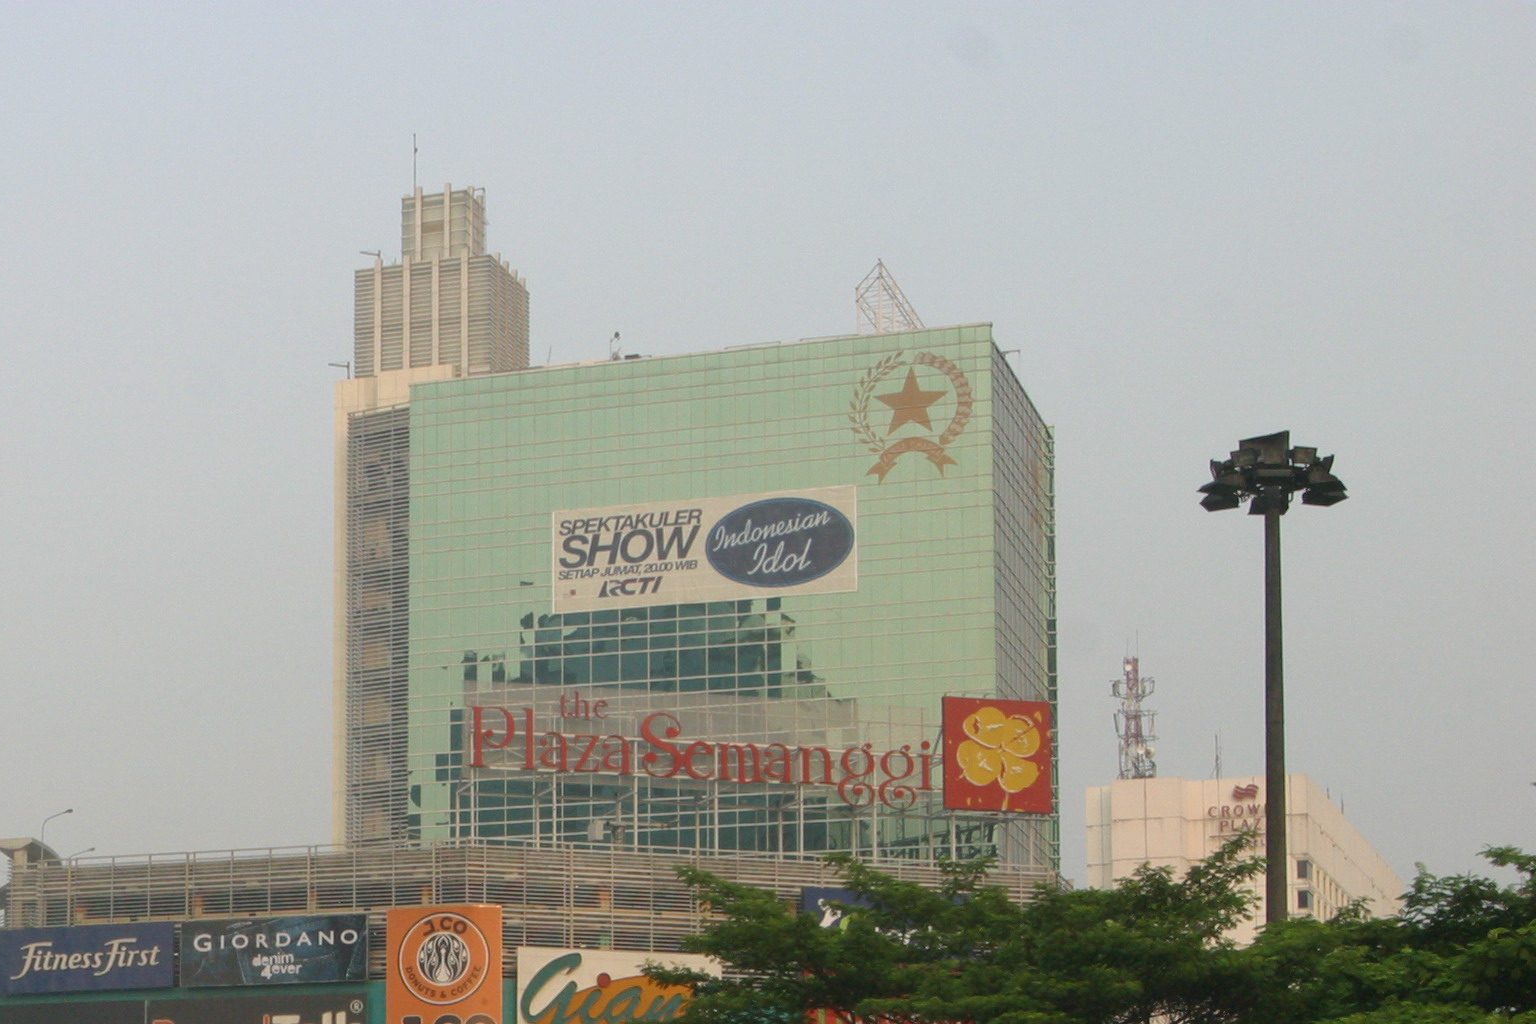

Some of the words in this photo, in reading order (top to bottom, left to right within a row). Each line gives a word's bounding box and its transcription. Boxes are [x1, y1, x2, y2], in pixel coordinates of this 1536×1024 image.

[559, 509, 702, 536] SPEKTAKULER
[712, 510, 831, 552] Indonesian
[559, 524, 701, 568] SHOW
[747, 539, 812, 575] Idol
[558, 568, 600, 580] SETIAP
[601, 563, 641, 577] JUMAT,
[644, 562, 673, 573] 20.00
[674, 560, 698, 571] WIB
[598, 576, 663, 598] RCTI
[560, 692, 609, 721] the
[469, 705, 633, 776] Plaza
[640, 712, 934, 810] Semanggi
[1207, 803, 1266, 818] CROW
[1219, 818, 1262, 832] PLAZ
[423, 916, 467, 936] J.CO
[193, 928, 359, 952] GIORDANO
[10, 941, 104, 980] Fitness
[93, 937, 161, 976] First
[252, 951, 294, 967] denim
[260, 964, 302, 980] 4ever
